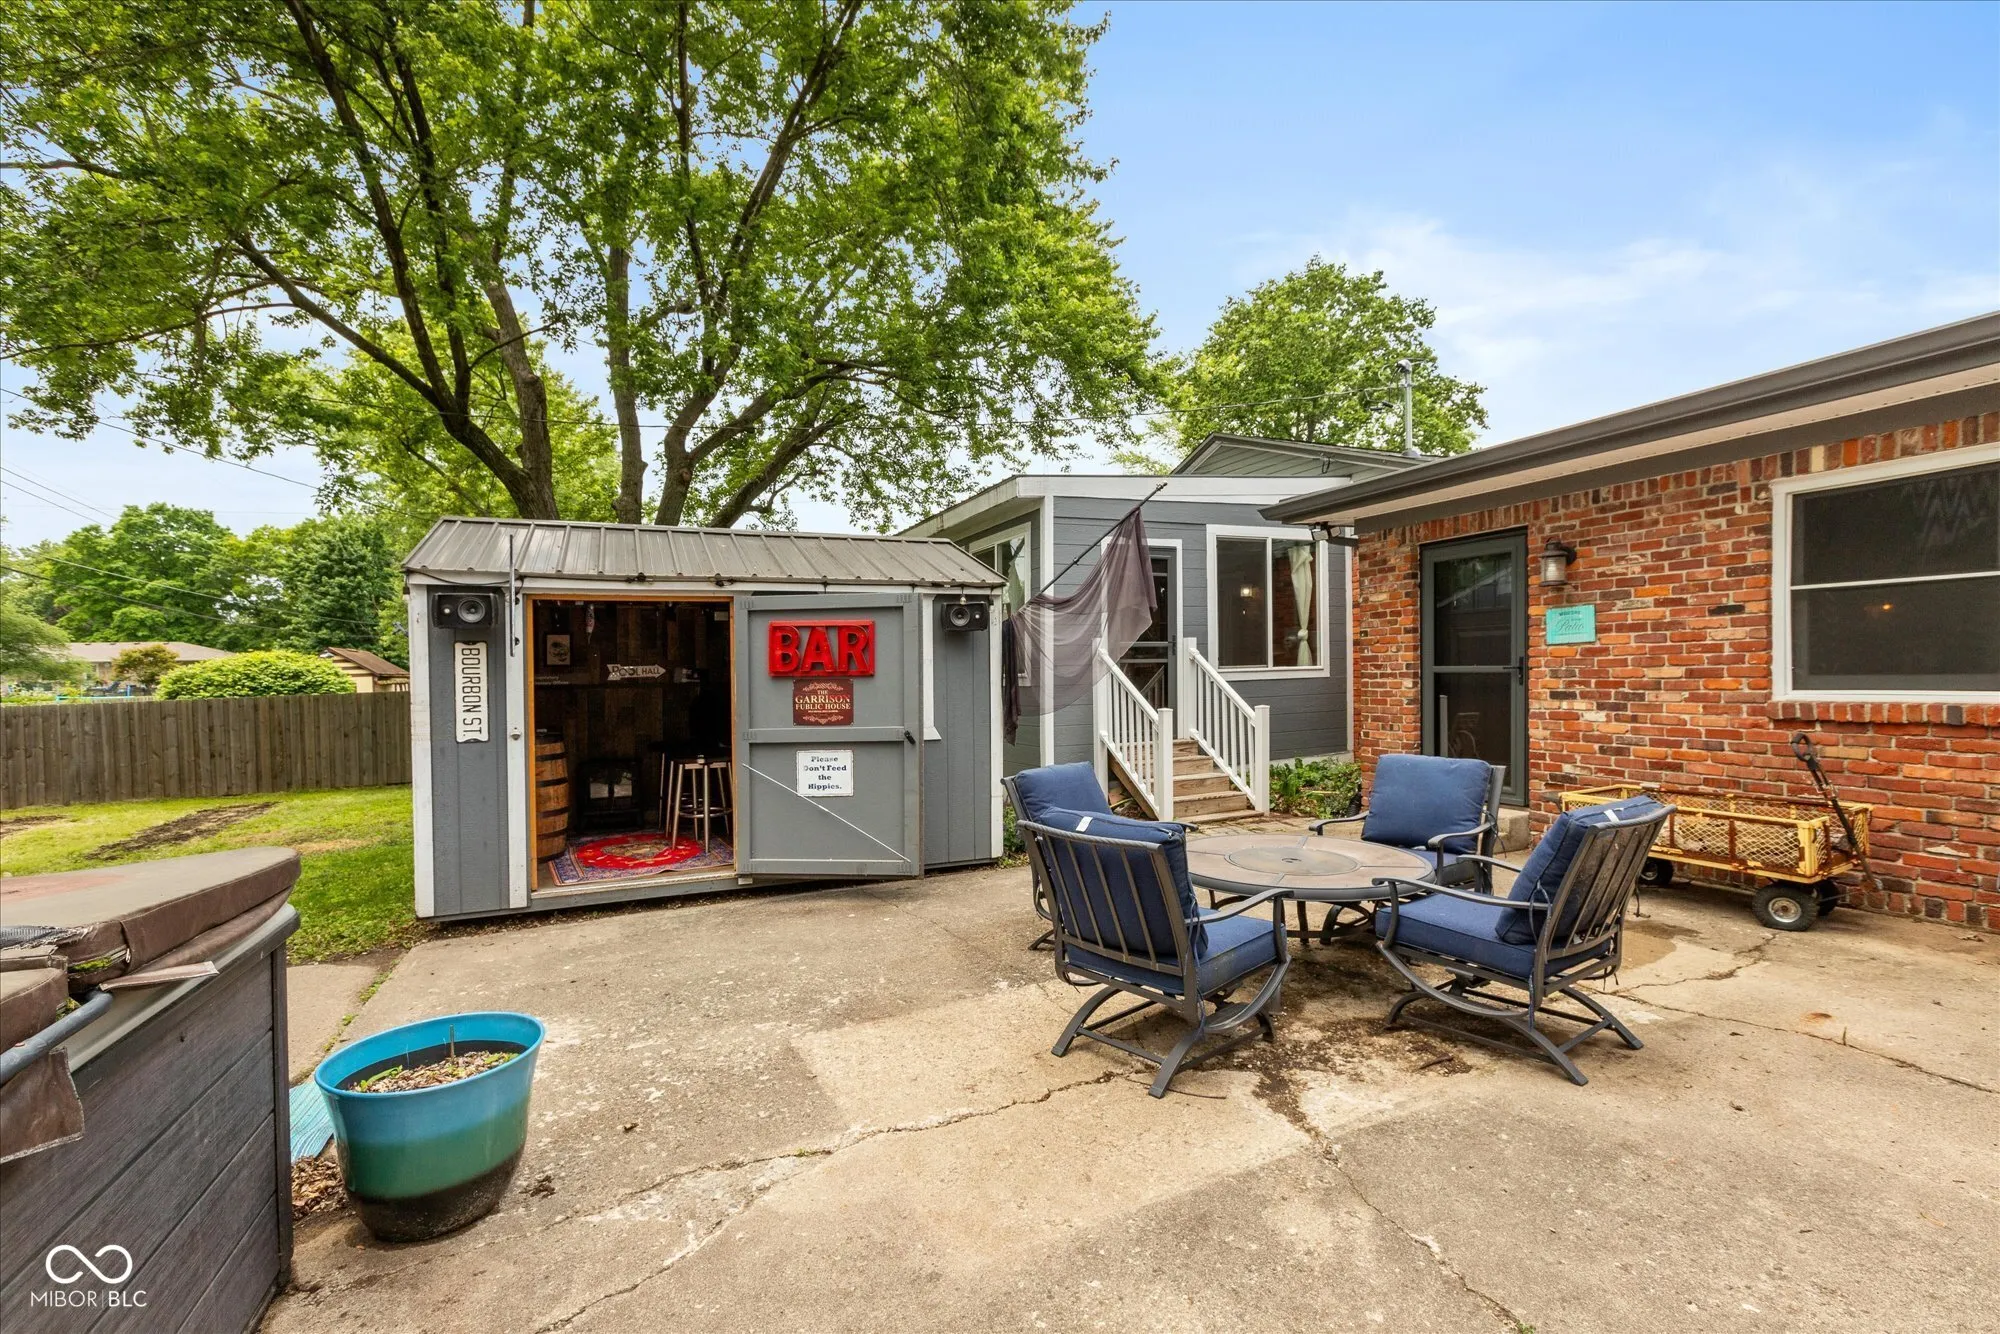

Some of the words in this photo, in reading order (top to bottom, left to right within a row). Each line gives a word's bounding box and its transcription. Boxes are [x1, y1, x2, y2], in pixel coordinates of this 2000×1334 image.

[770, 625, 869, 673] BAR
[611, 665, 639, 677] POOL
[641, 666, 661, 675] HALL
[461, 647, 481, 713] BOURBON
[795, 695, 850, 703] GARRISON
[463, 717, 482, 737] ST.
[808, 783, 842, 791] Hippies.
